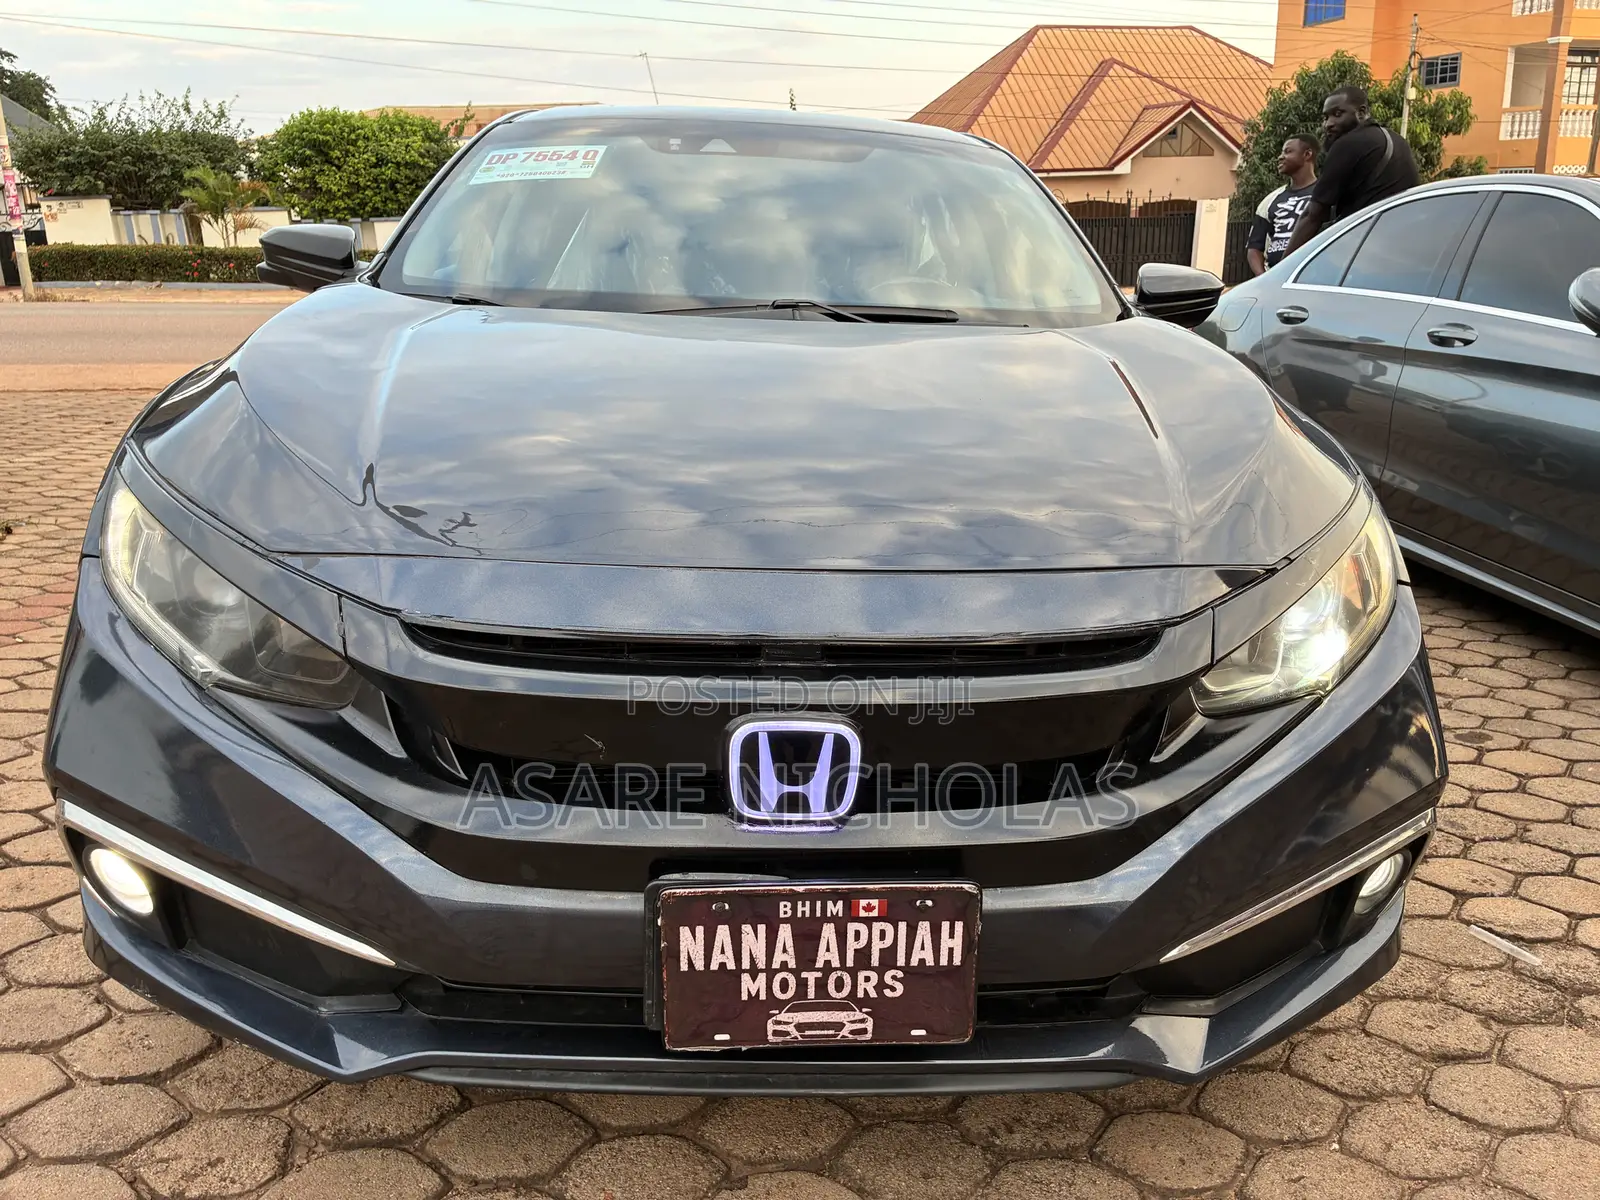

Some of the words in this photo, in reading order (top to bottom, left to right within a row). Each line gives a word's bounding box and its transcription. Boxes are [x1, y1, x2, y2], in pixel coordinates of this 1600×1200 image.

[486, 153, 519, 166] DP
[520, 150, 579, 163] 7554
[779, 900, 844, 918] BHIM
[679, 923, 797, 972] NANA
[814, 920, 964, 968] APPIAH
[740, 969, 905, 1001] MOTORS
